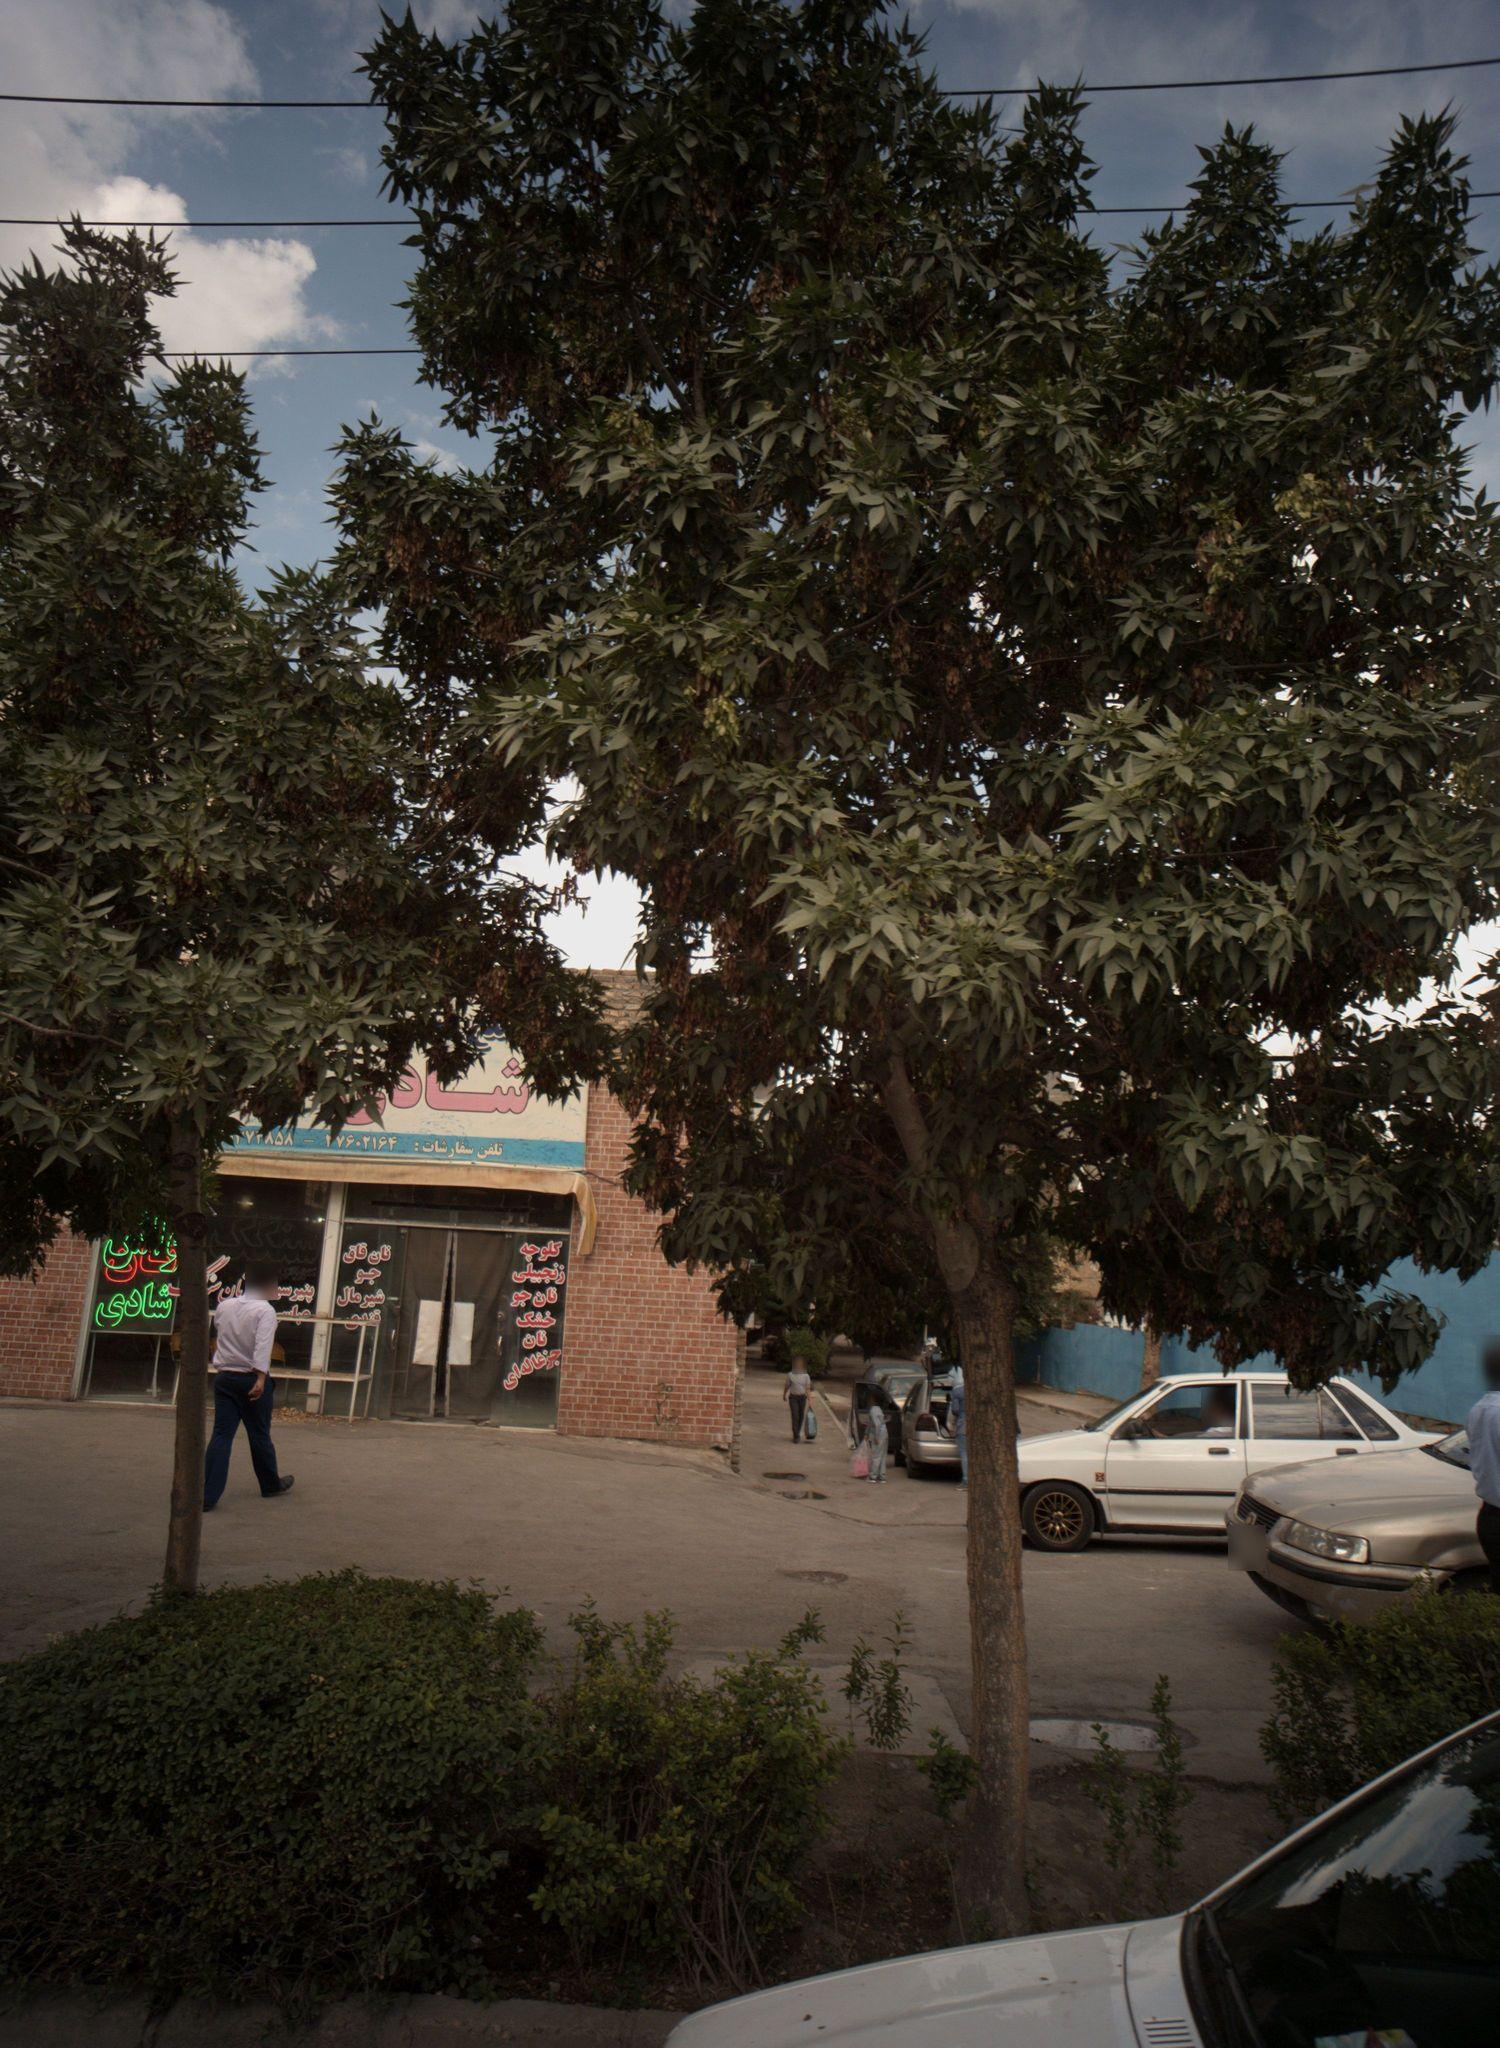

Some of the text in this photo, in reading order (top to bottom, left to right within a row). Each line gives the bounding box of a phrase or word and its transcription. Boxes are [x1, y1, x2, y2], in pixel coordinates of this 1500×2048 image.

[477, 1142, 504, 1160] تلفن
[368, 1244, 391, 1265] نان
[520, 1240, 563, 1262] کلوچه
[354, 1267, 382, 1285] جو
[512, 1262, 566, 1284] زنجبیلی
[289, 1283, 316, 1304] پنیر
[337, 1286, 386, 1308] شیر مال
[511, 1287, 558, 1307] نان جو
[96, 1281, 173, 1328] شادی
[516, 1311, 557, 1328] خشک
[522, 1330, 548, 1349] نان
